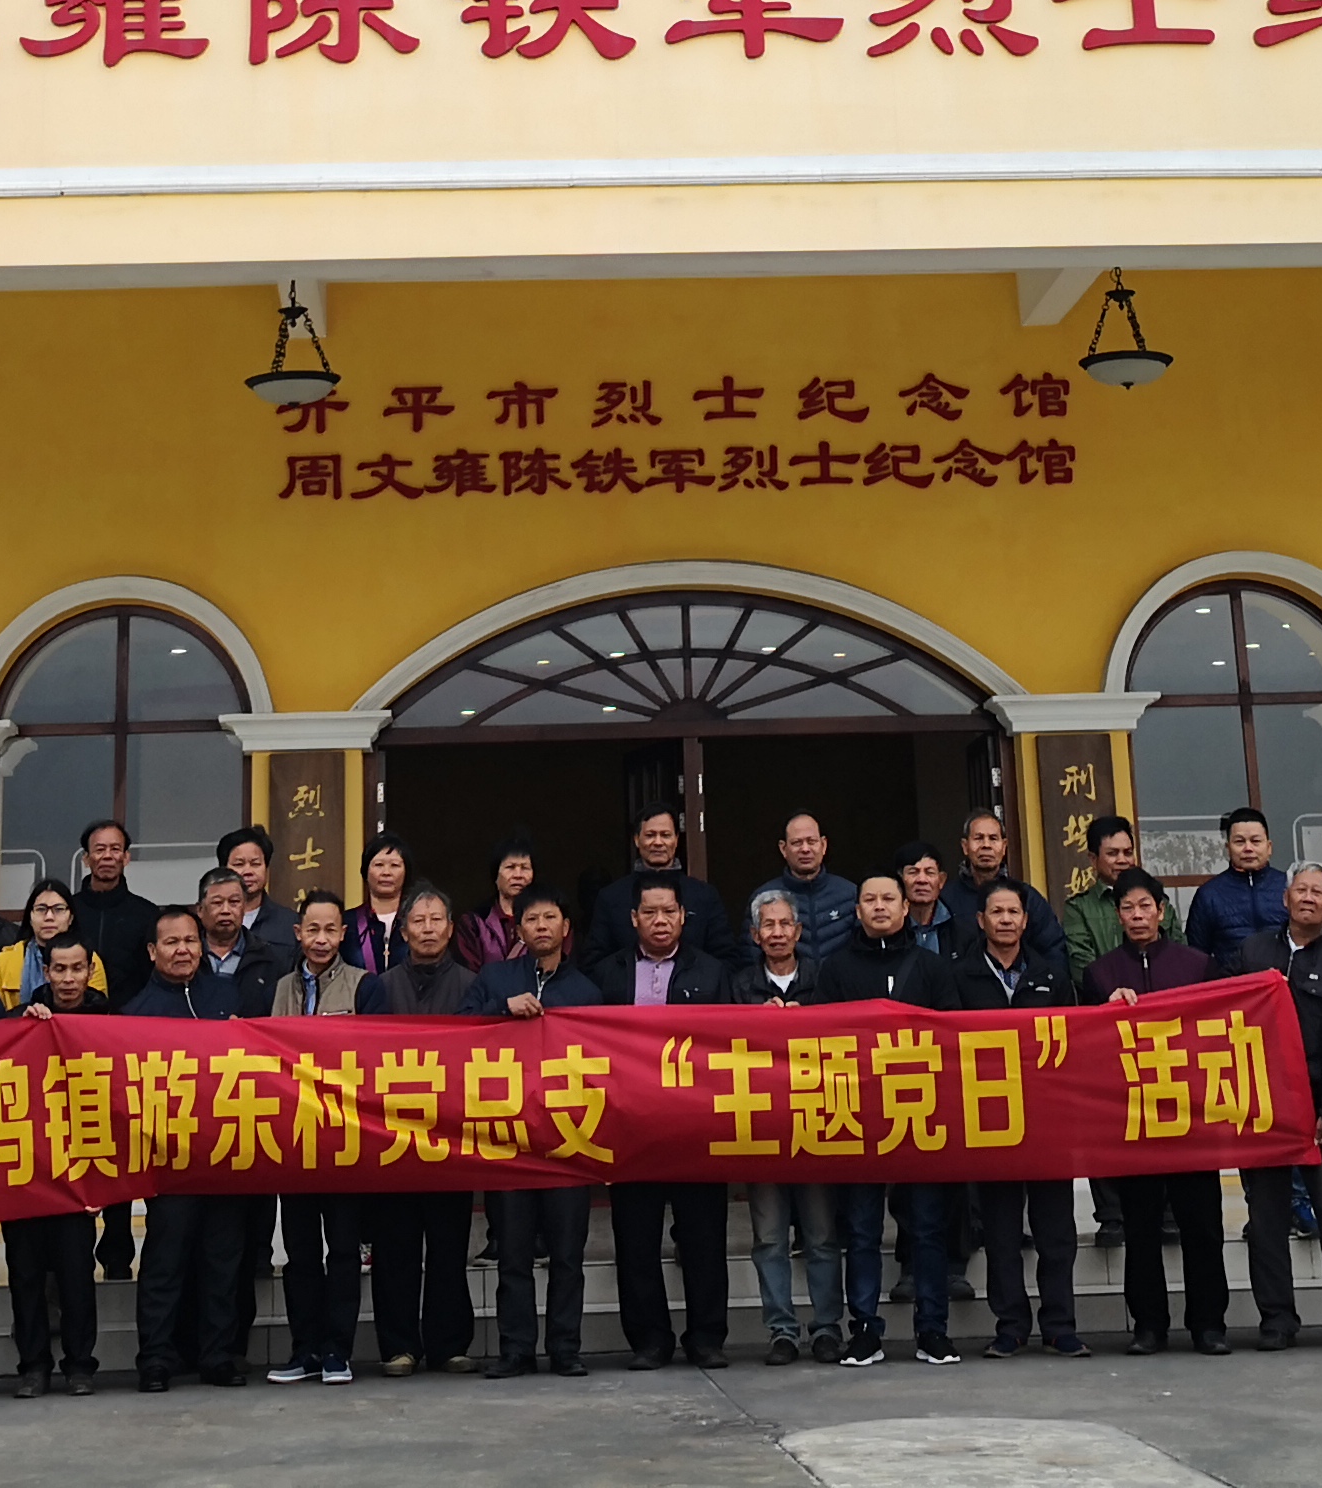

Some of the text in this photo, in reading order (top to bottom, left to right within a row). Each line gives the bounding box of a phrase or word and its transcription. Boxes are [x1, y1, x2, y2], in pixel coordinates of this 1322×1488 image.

[277, 438, 1077, 502] 周文雍陈铁军烈士纪念馆
[288, 783, 325, 912] 烈士
